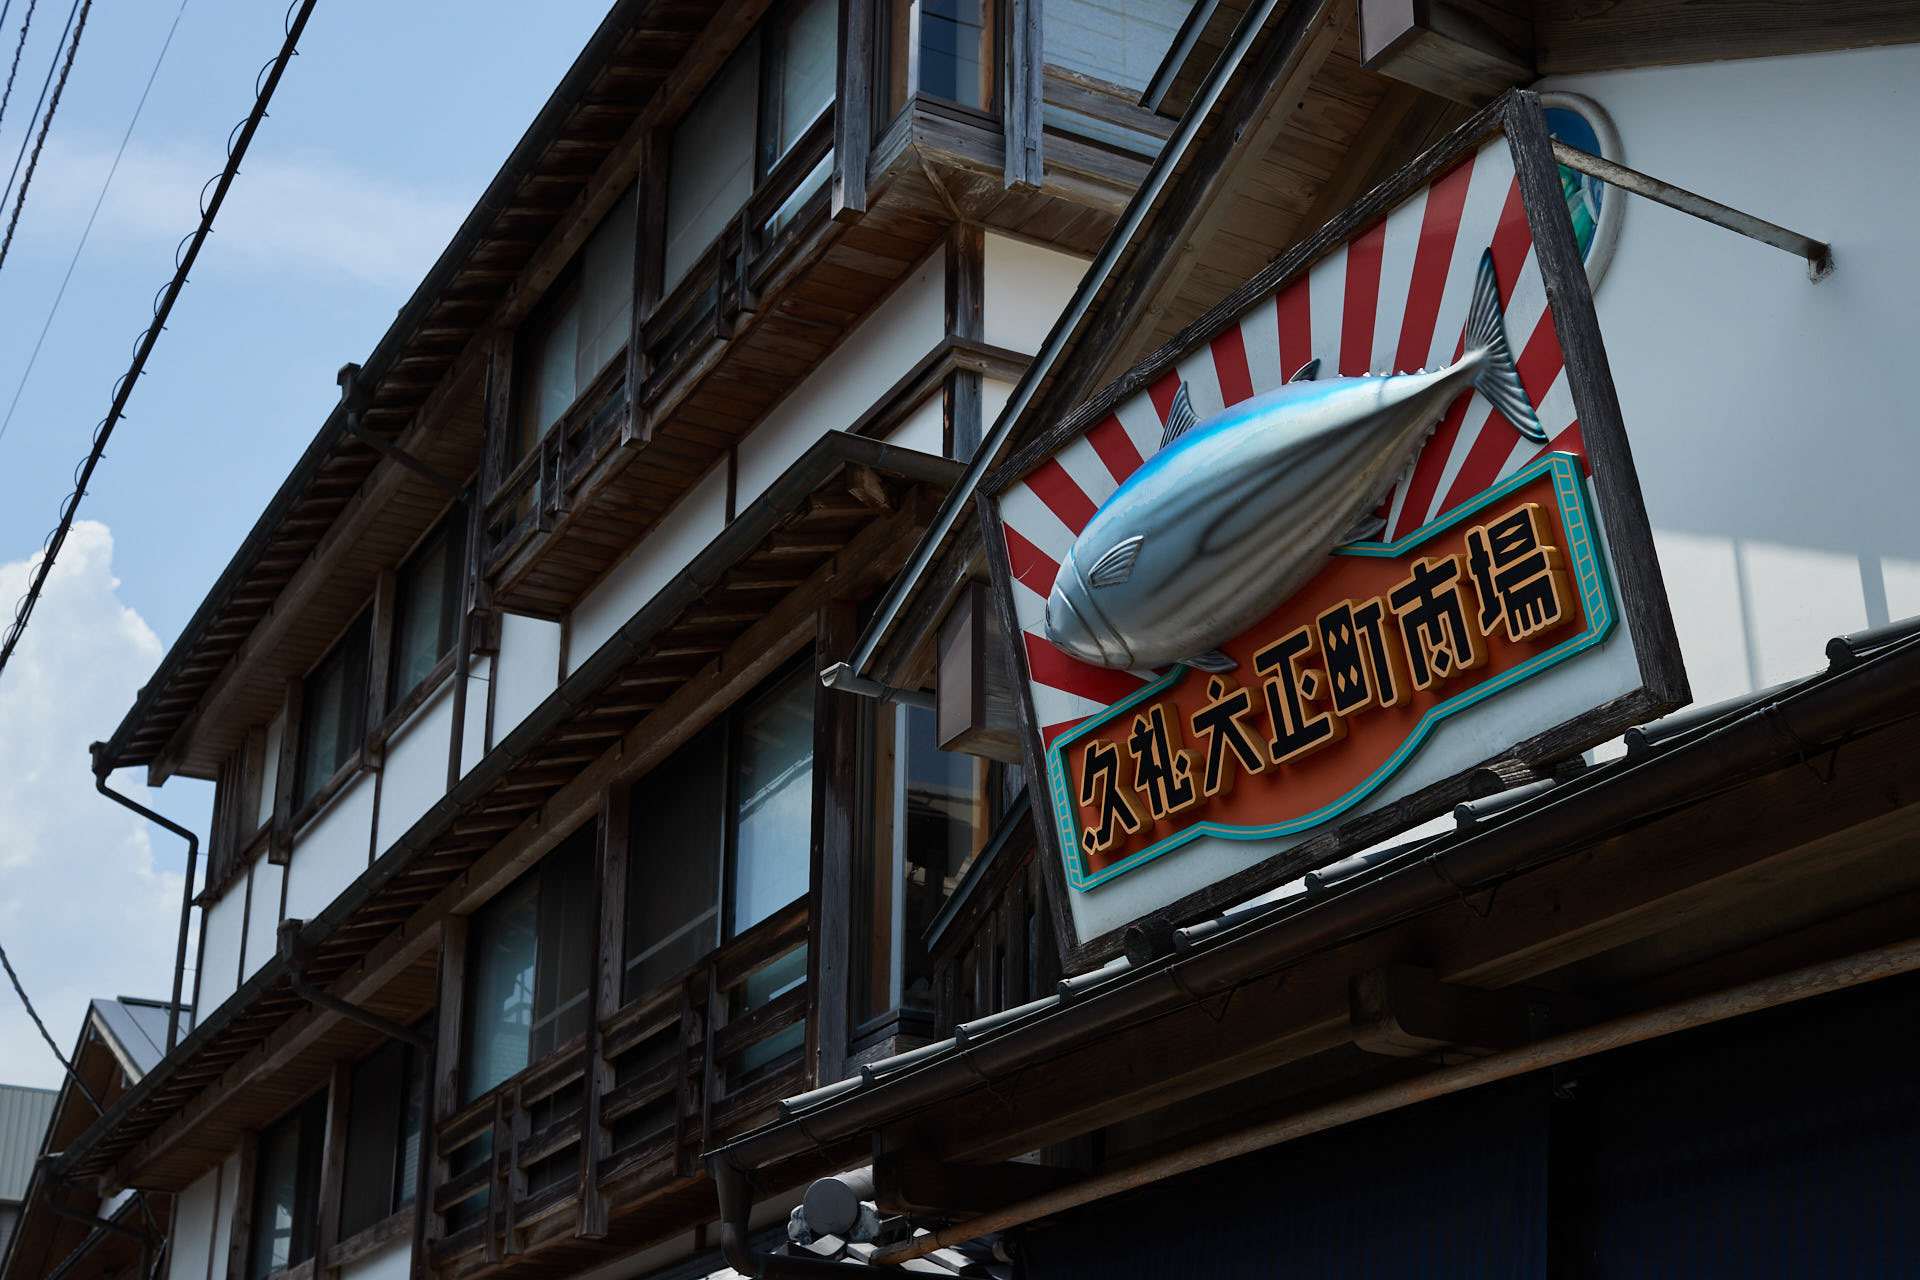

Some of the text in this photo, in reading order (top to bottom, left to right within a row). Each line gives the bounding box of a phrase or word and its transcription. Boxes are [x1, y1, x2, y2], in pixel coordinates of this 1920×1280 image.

[1081, 502, 1564, 855] 久礼大正町市場
